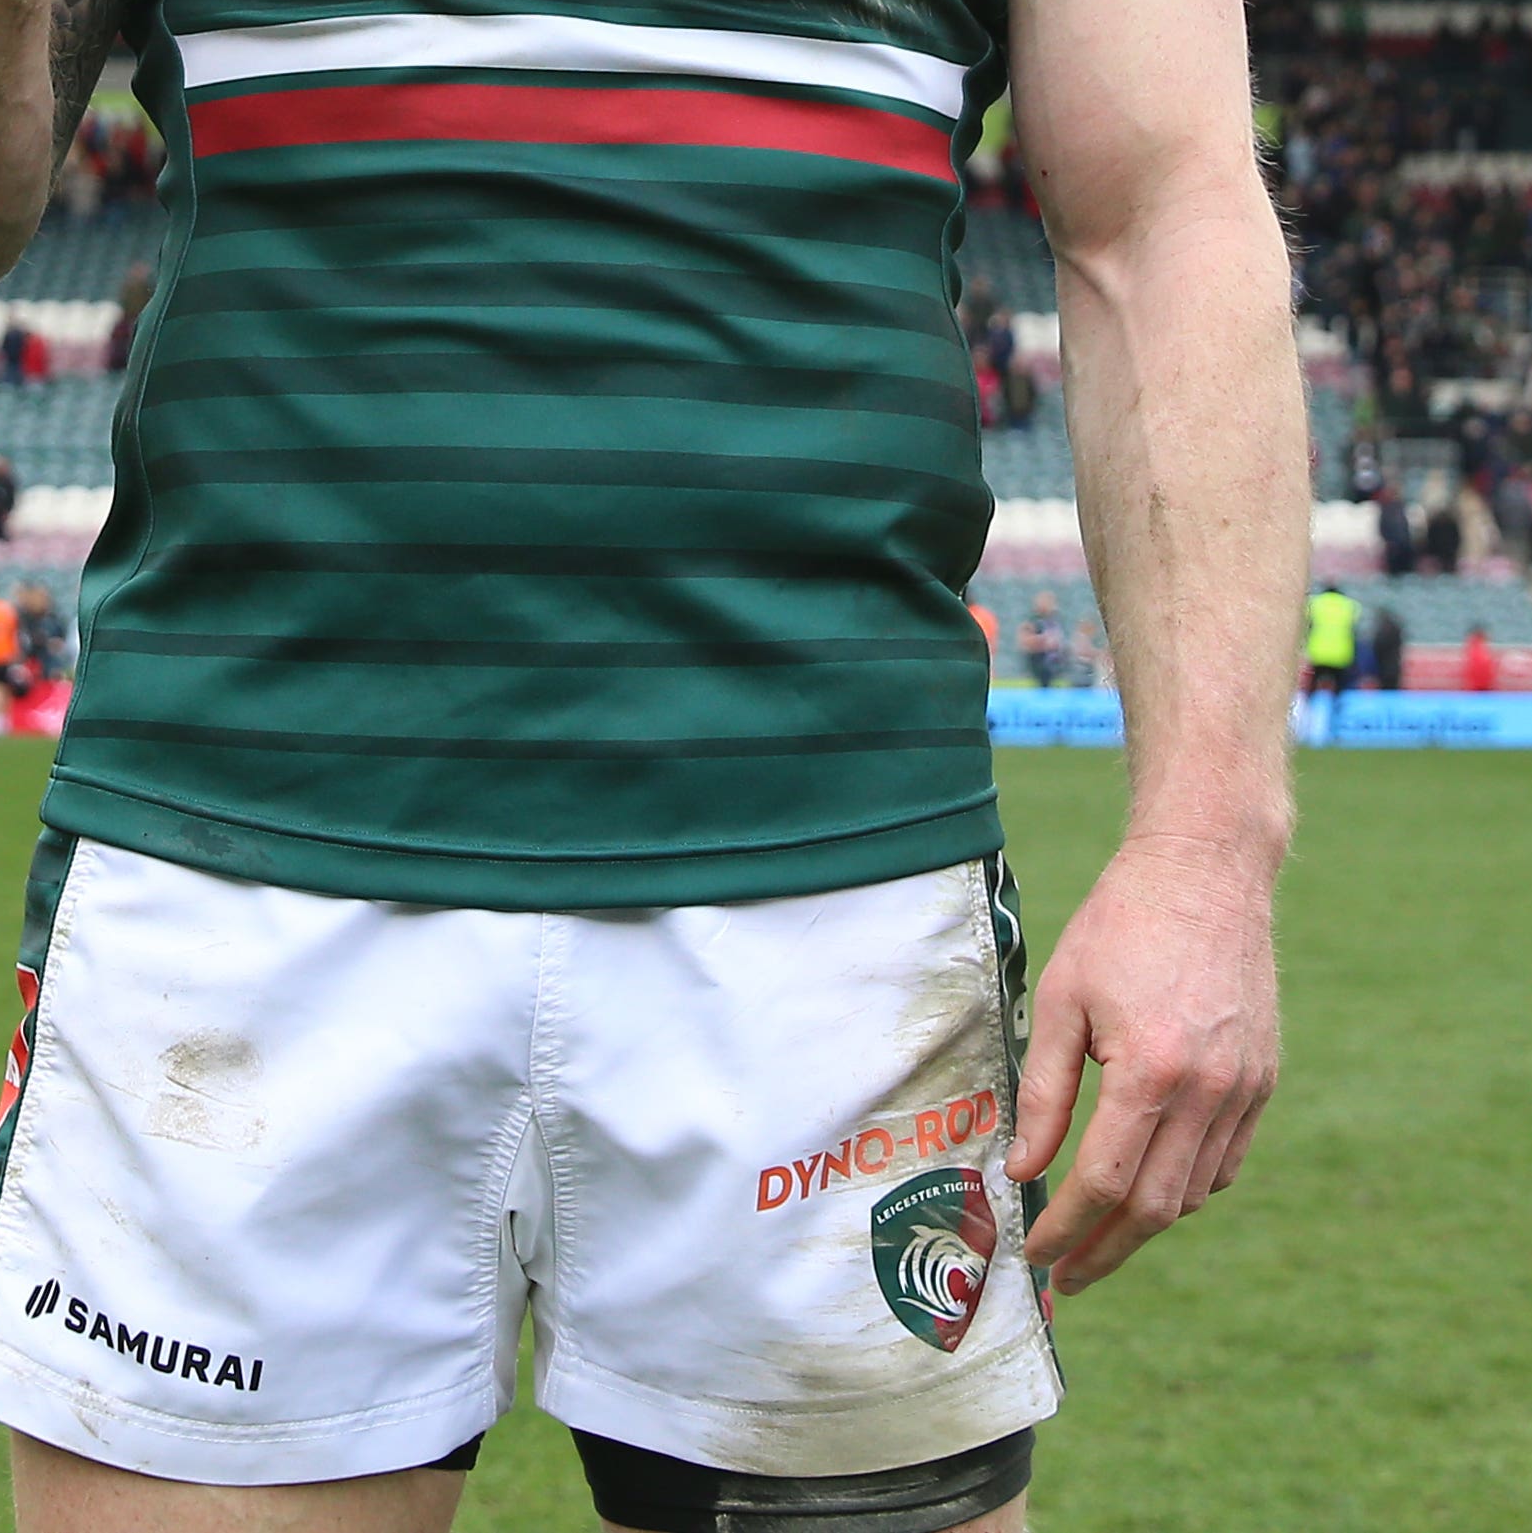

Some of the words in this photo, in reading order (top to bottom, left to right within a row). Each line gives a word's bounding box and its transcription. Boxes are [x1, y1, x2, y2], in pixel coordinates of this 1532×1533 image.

[756, 1089, 999, 1212] DYNO-ROD
[876, 1186, 941, 1225] LEICESTER
[943, 1181, 981, 1193] TIGERS
[64, 1296, 265, 1392] SAMURAI
